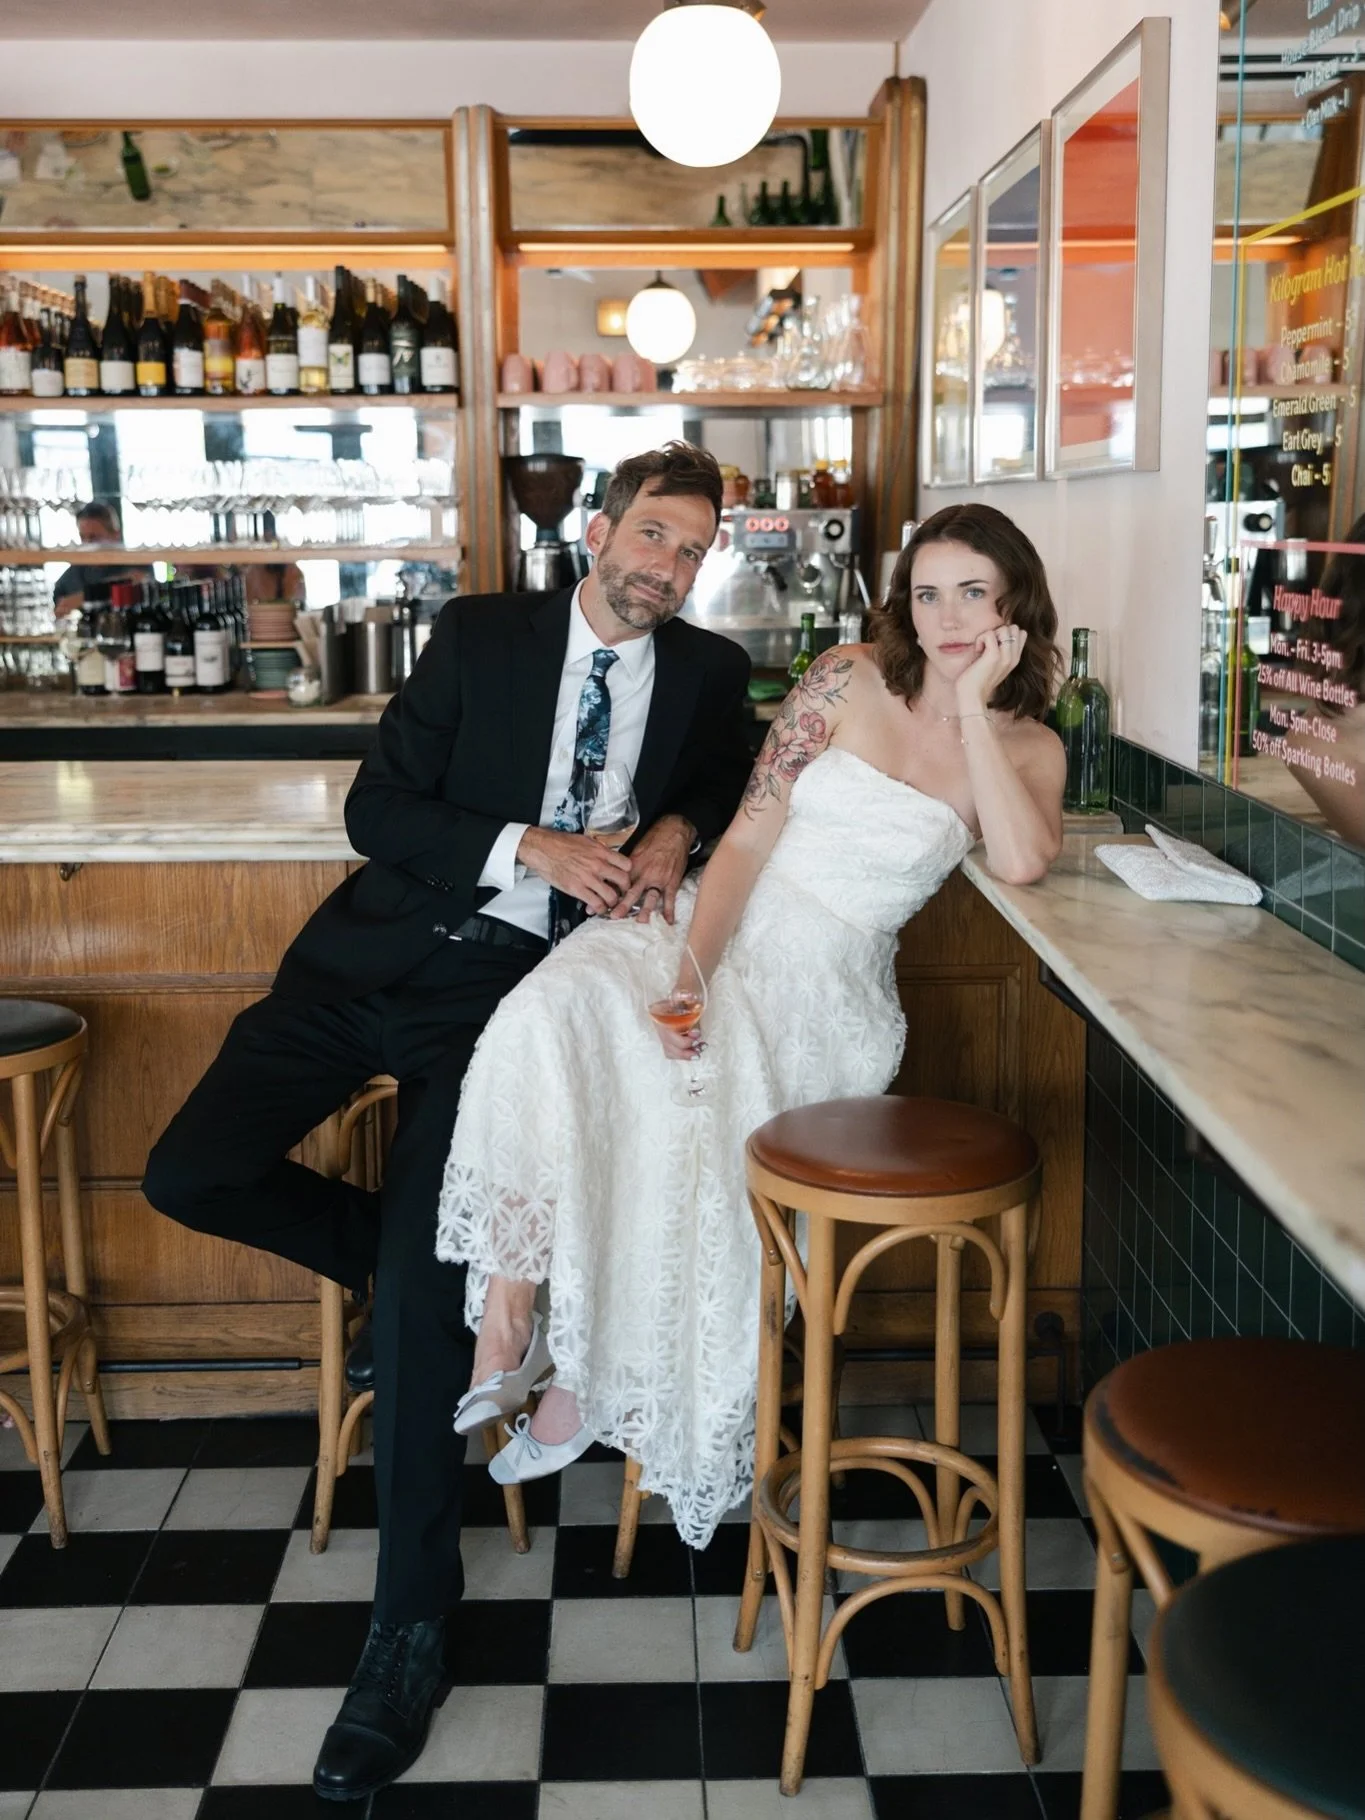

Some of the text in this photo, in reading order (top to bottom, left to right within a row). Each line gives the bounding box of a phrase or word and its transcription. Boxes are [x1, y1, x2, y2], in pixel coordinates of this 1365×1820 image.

[1309, 14, 1337, 50] Blend
[1338, 3, 1360, 32] Drip
[1295, 69, 1314, 97] Cold
[1315, 56, 1339, 86] Brew
[1270, 268, 1323, 306] Kilogram
[1324, 254, 1347, 286] Hot
[1280, 316, 1333, 349] Peppermint
[1345, 309, 1352, 331] 5
[1280, 352, 1332, 383] Chamomile
[1343, 347, 1350, 370] 5
[1272, 395, 1308, 418] Emerald
[1308, 392, 1336, 413] Green
[1349, 385, 1356, 407] 5
[1282, 431, 1300, 451] Earl
[1301, 428, 1323, 455] Grey
[1335, 424, 1343, 447] 5
[1291, 464, 1314, 487] Chai
[1322, 463, 1331, 486] 5
[1273, 585, 1343, 622] Happy Hour
[1270, 633, 1289, 656] Mon.
[1296, 638, 1310, 662] Fri.
[1312, 642, 1342, 671] 3-5pm
[1257, 663, 1355, 708] 25% off All Wine Bottles
[1269, 703, 1288, 728] Mon.
[1252, 730, 1356, 786] 50% off Sparkling Bottles
